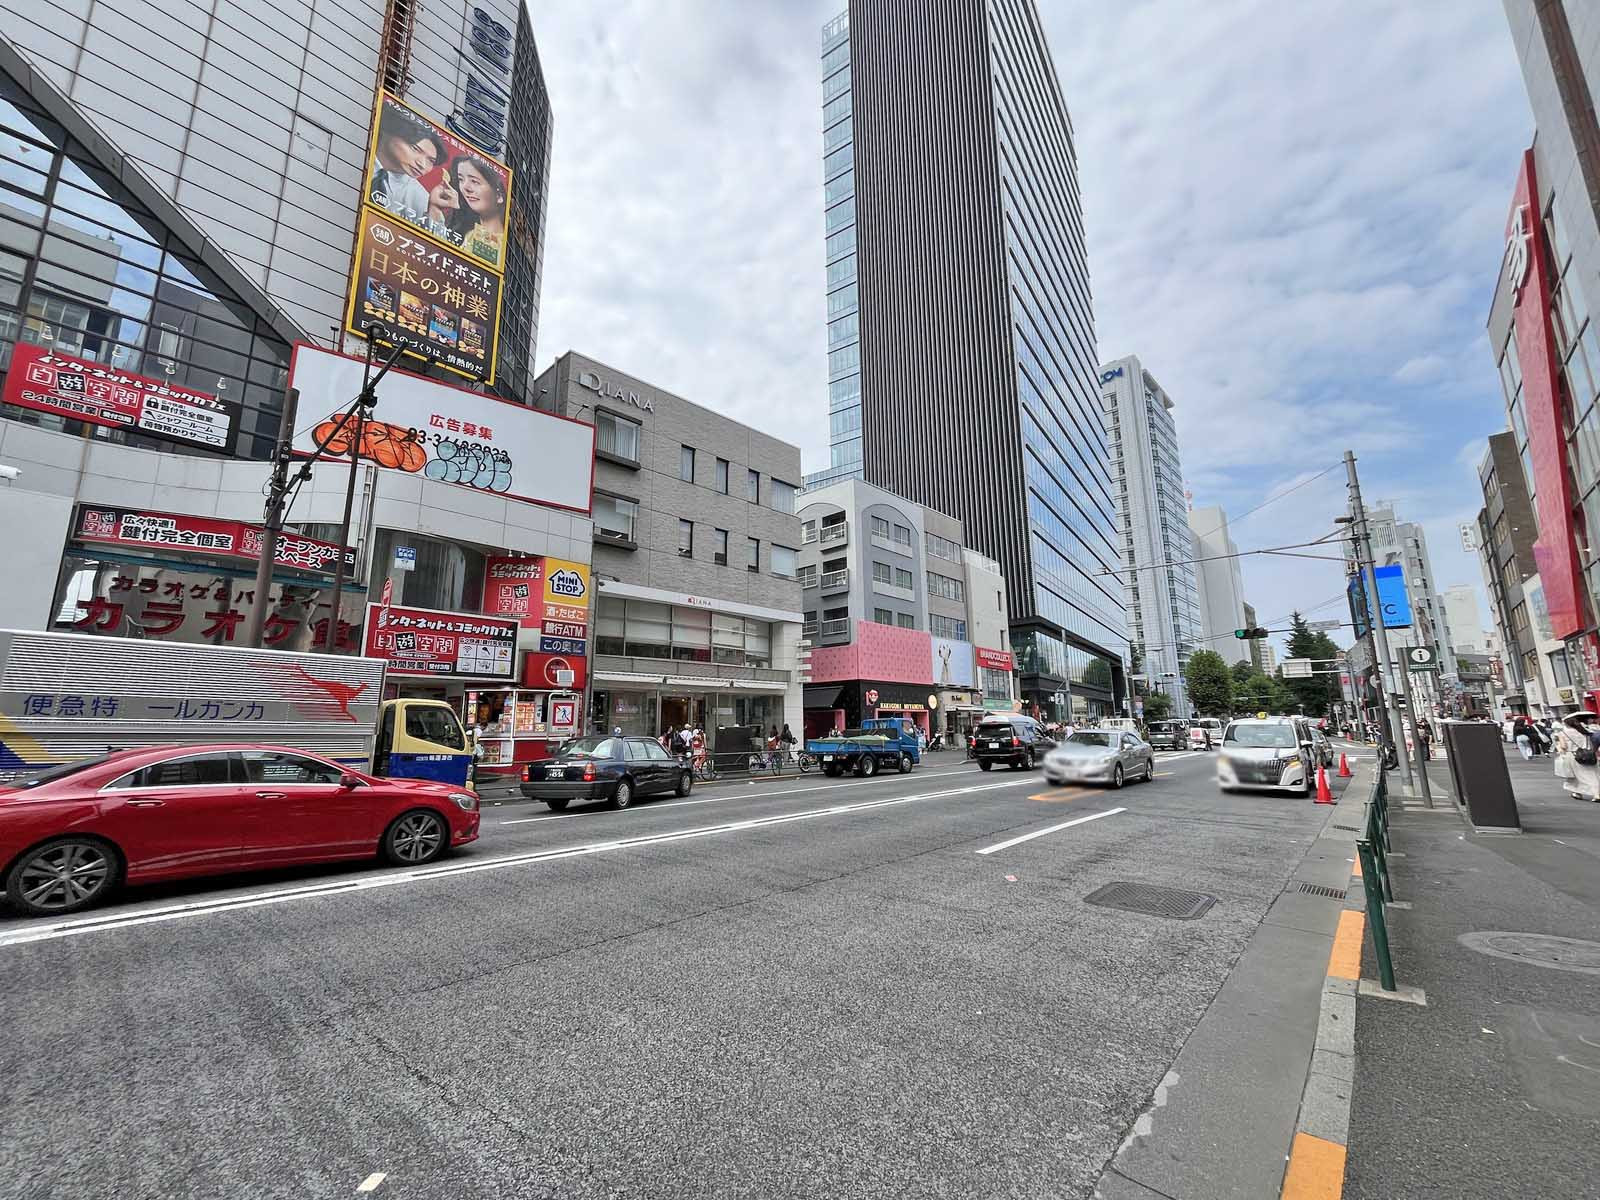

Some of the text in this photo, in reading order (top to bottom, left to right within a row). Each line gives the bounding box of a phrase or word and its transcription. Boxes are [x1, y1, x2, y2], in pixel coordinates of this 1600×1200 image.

[398, 234, 492, 289] プライドポテト
[370, 248, 489, 321] 日本の神業
[29, 364, 139, 407] 自遊空間
[578, 372, 654, 412] DIANA
[429, 414, 493, 440] 広告募集
[120, 524, 233, 550] 鍵付完全個室
[555, 584, 579, 594] STOP
[557, 575, 578, 586] MINI
[376, 631, 453, 654] 自遊空間
[544, 622, 584, 638] 銀行ATM
